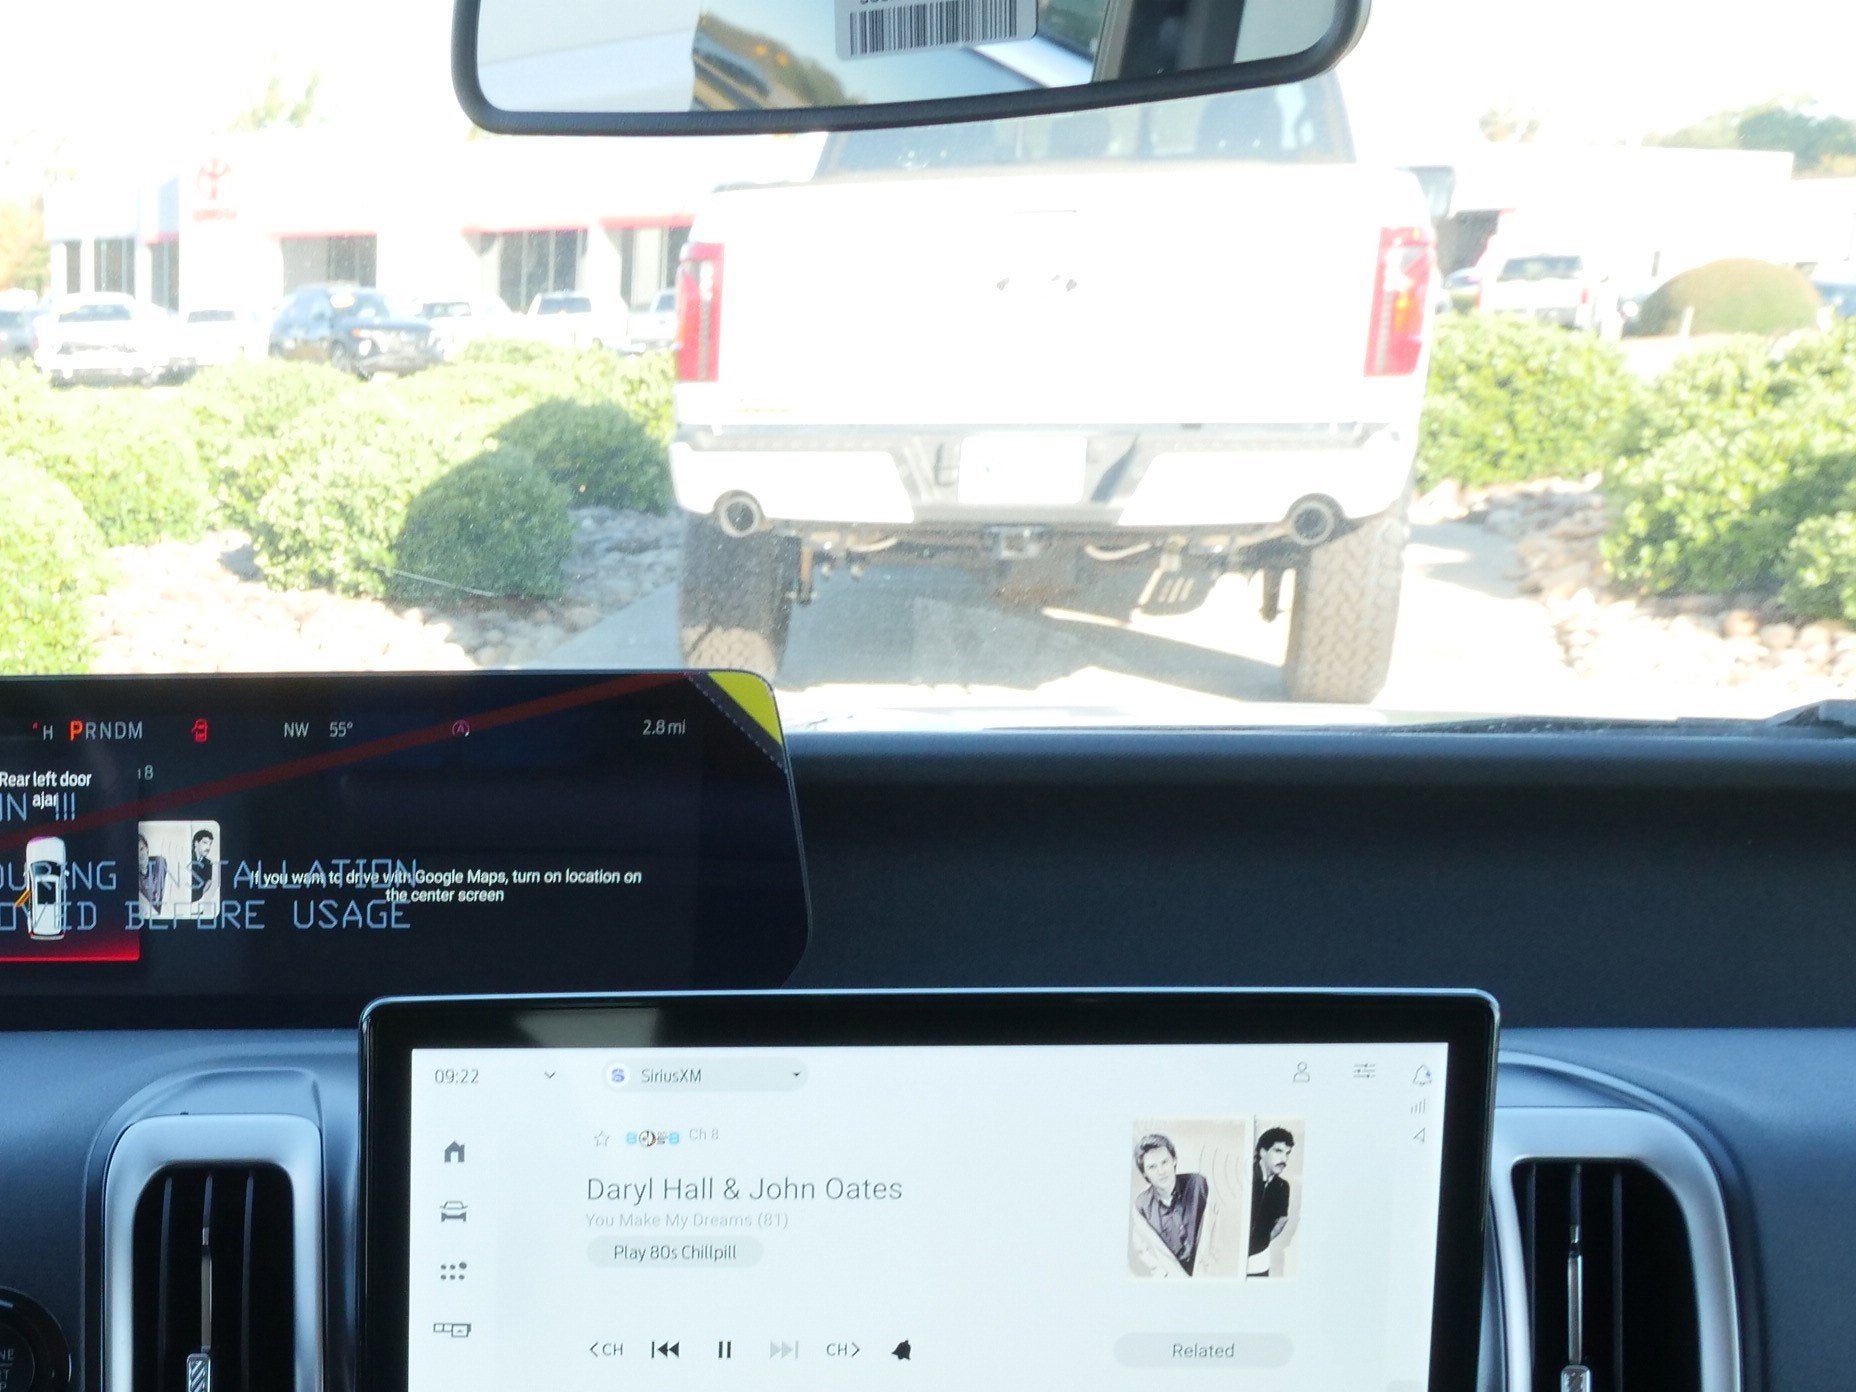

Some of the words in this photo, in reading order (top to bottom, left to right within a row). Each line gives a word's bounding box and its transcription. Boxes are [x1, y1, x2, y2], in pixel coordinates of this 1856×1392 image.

[283, 722, 309, 738] NW
[643, 719, 665, 736] 2.8
[668, 719, 686, 735] mi
[0, 771, 30, 787] Rear
[32, 770, 57, 787] left
[59, 770, 92, 787] door
[32, 792, 59, 809] ajar
[145, 858, 417, 890] INSTALLATION
[263, 872, 288, 887] you
[415, 869, 463, 887] Google
[467, 870, 509, 885] Maps,
[512, 871, 540, 884] turn
[544, 873, 562, 884] on
[565, 869, 621, 884] location
[624, 873, 642, 884] on
[385, 888, 408, 902] the
[410, 889, 453, 902] center
[458, 890, 505, 902] screen
[125, 899, 266, 930] BEFORE
[293, 899, 411, 929] USAGE
[434, 1069, 480, 1084] 09:22
[641, 1068, 702, 1083] SiriusXM
[587, 1177, 653, 1206] Daryl
[663, 1177, 714, 1200] Hall
[723, 1177, 740, 1200] &
[749, 1177, 815, 1200] John
[825, 1177, 903, 1200] Oates
[586, 1213, 614, 1227] You
[620, 1213, 661, 1227] Make
[665, 1213, 688, 1230] My
[693, 1213, 752, 1227] Dreams
[757, 1212, 789, 1230] (81)
[614, 1244, 646, 1262] Play
[650, 1244, 678, 1260] 80s
[681, 1244, 737, 1262] Chillpill
[602, 1343, 624, 1356] CH
[826, 1343, 848, 1357] CH
[1171, 1341, 1236, 1359] Related
